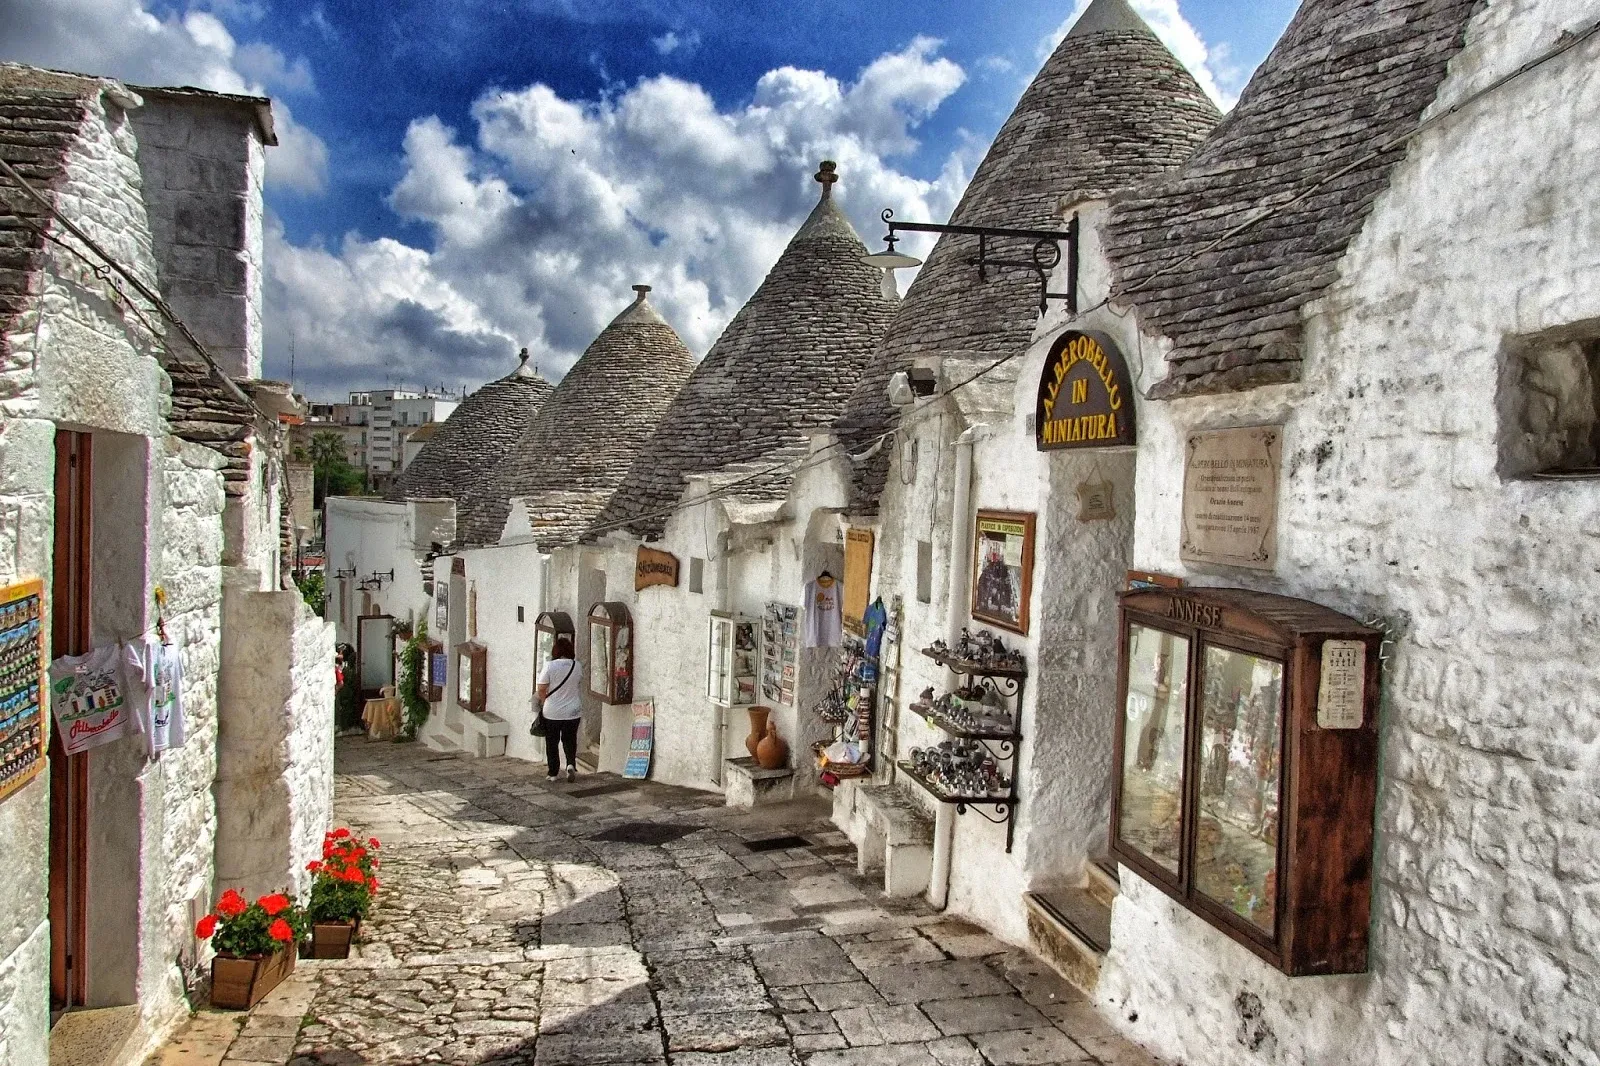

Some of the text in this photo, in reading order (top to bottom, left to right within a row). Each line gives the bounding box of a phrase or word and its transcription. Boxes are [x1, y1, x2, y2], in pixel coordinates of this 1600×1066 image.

[1043, 335, 1121, 419] ALBEROBELLO
[1071, 378, 1087, 404] IN
[1042, 412, 1117, 444] MINIATURA
[1167, 597, 1220, 627] ANNESE
[70, 710, 119, 739] Alberobello
